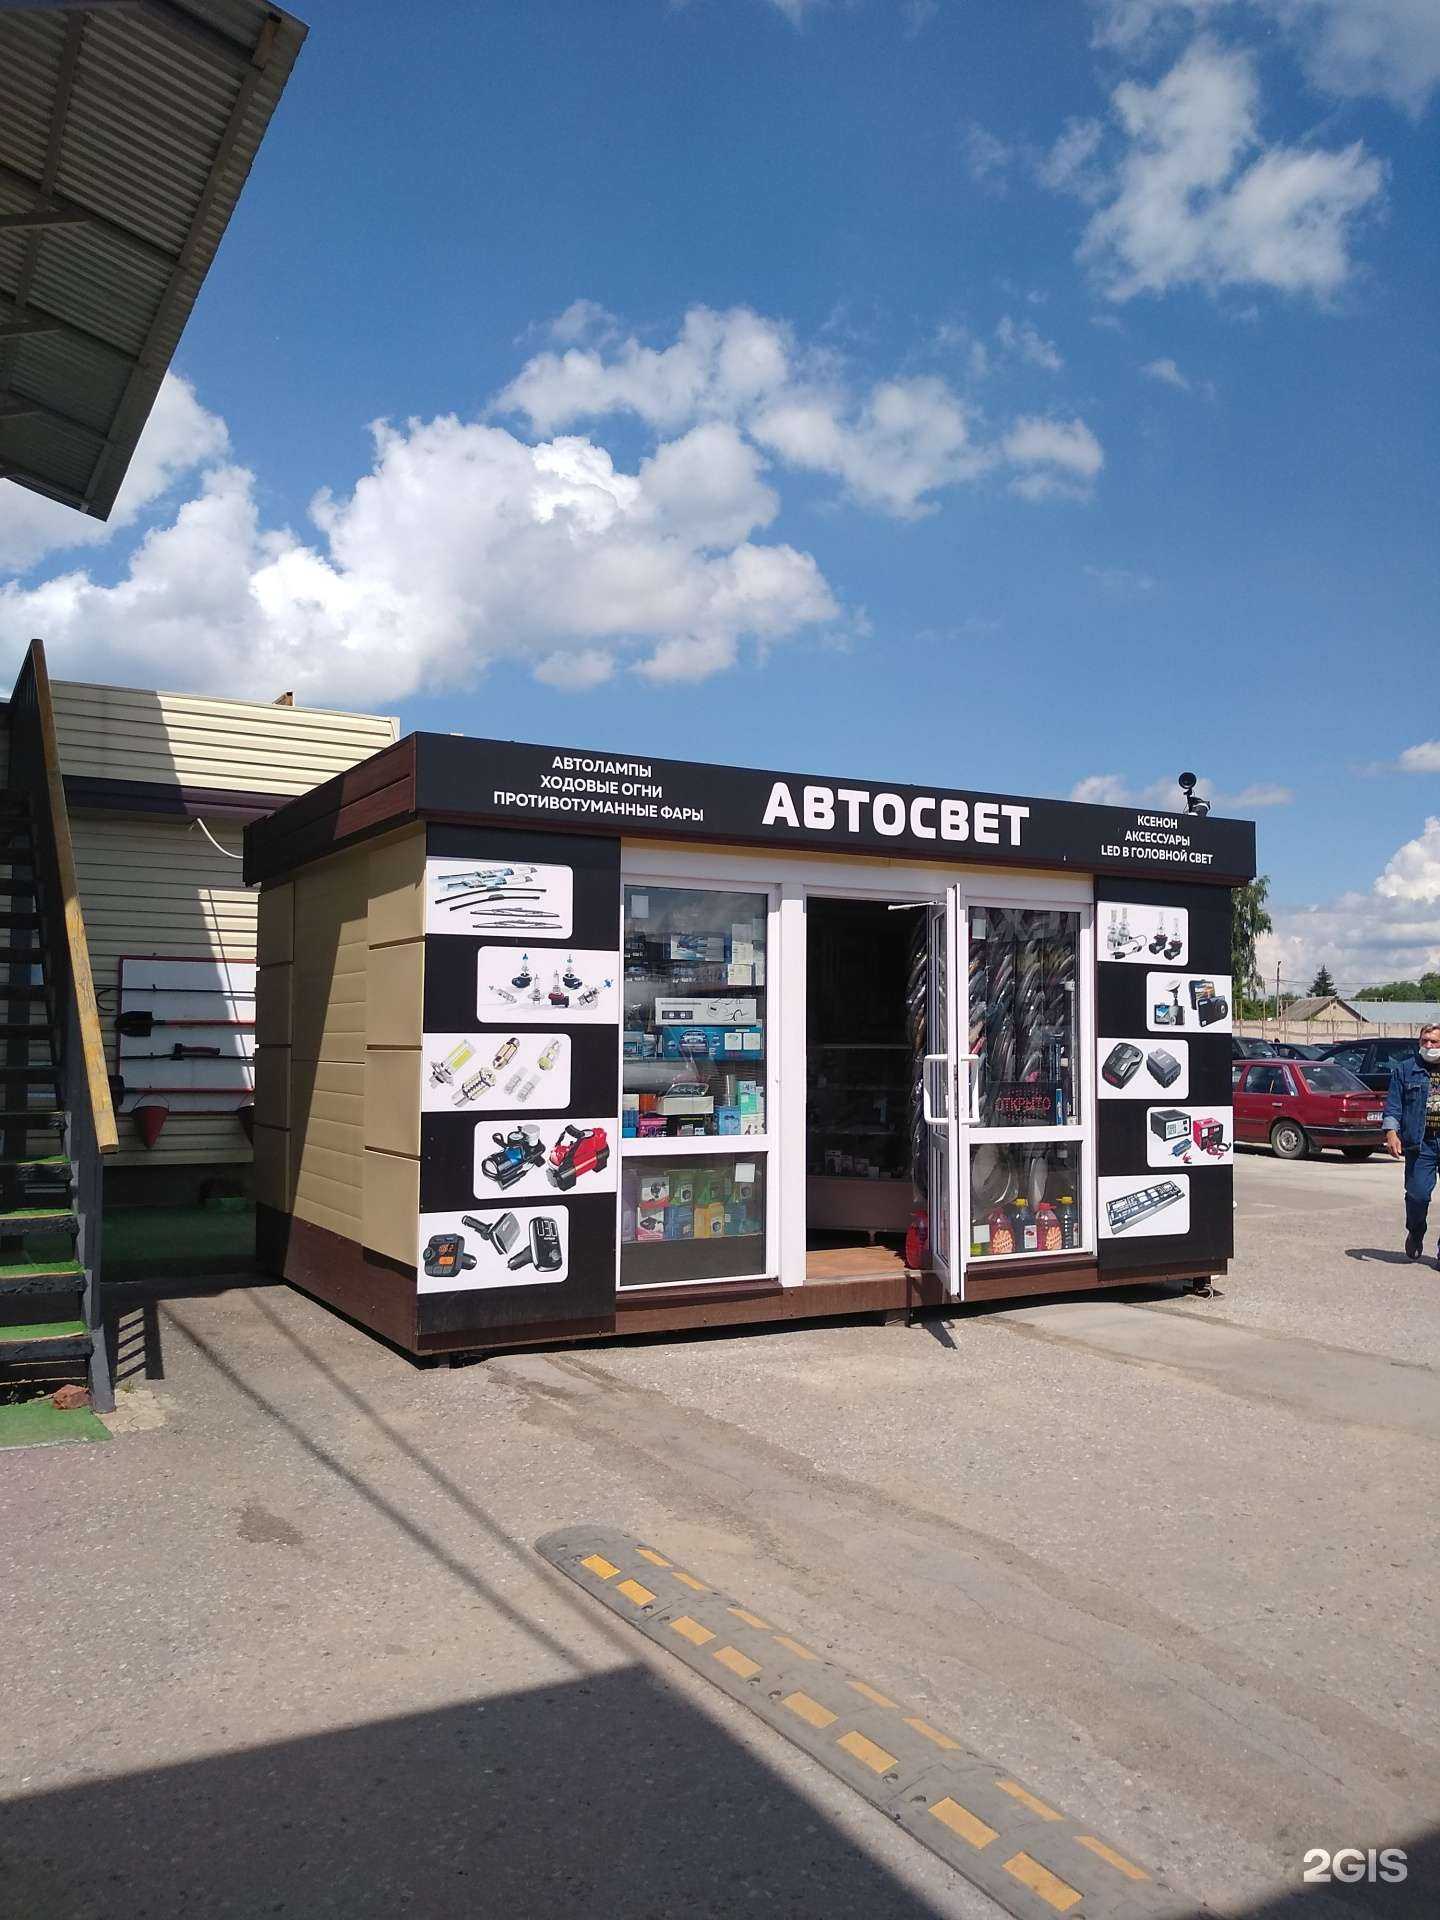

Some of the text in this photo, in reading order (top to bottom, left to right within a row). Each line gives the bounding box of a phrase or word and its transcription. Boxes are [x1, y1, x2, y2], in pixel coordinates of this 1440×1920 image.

[552, 756, 652, 778] АВТОЛАМПЫ
[540, 774, 663, 798] ХОДОВЫЕ ОГНИ
[493, 790, 704, 821] ПРОТИВОТУМАННЫЕ ФАРЫ
[761, 781, 1030, 847] АВТОСВЕТ
[1137, 814, 1178, 830] КСЕНОН
[1124, 830, 1191, 847] АКСЕССУАРЫ
[1101, 844, 1213, 864] LED В ГОЛОВНОЙ СВЕТ
[994, 1096, 1052, 1113] ОТКРЫТО
